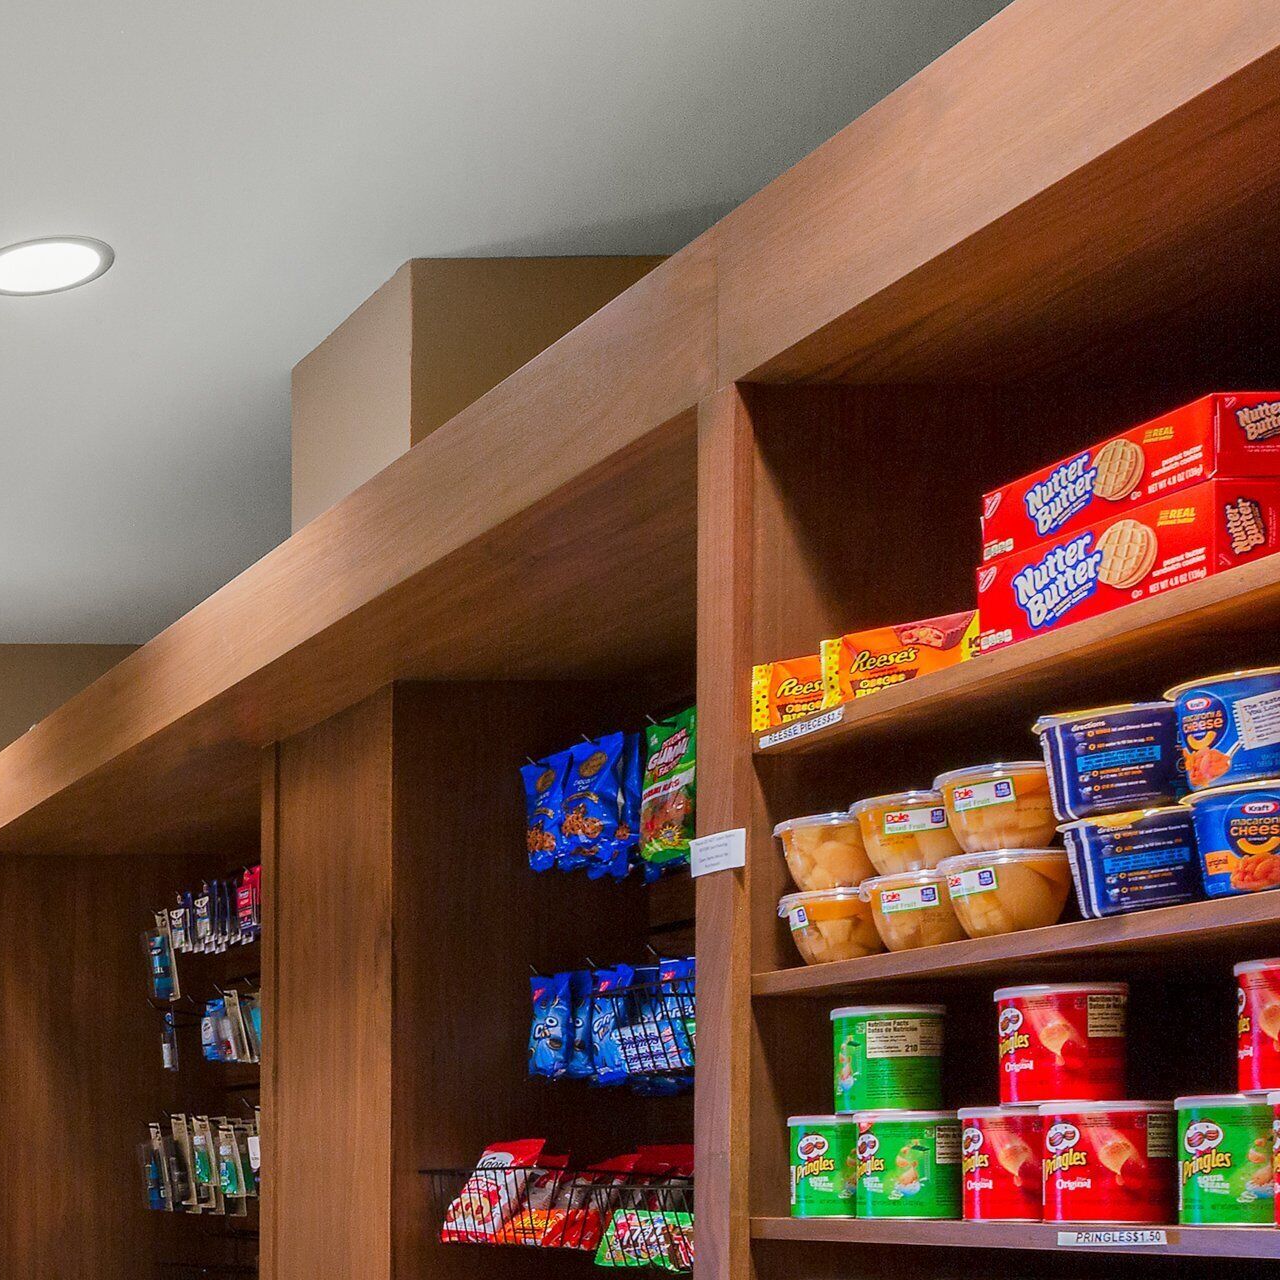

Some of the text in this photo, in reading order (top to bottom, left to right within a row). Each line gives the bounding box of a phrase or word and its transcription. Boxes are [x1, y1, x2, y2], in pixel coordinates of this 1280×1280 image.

[1026, 453, 1089, 512] Nutter
[1035, 468, 1096, 534] Butter
[1014, 533, 1091, 598] Nutter
[1027, 551, 1102, 627] Butter
[850, 648, 919, 674] Reese's
[768, 726, 797, 743] REESSE
[1071, 720, 1105, 733] directions
[954, 788, 973, 800] Dole
[886, 813, 910, 823] Dole
[882, 892, 900, 902] Dole
[905, 1044, 919, 1053] 210
[796, 1157, 834, 1185] Pringles
[1045, 1150, 1087, 1181] Pringles
[1182, 1152, 1232, 1185] Pringles
[1056, 1177, 1091, 1190] Original
[1075, 1231, 1161, 1244] PRINGLES$1.50
